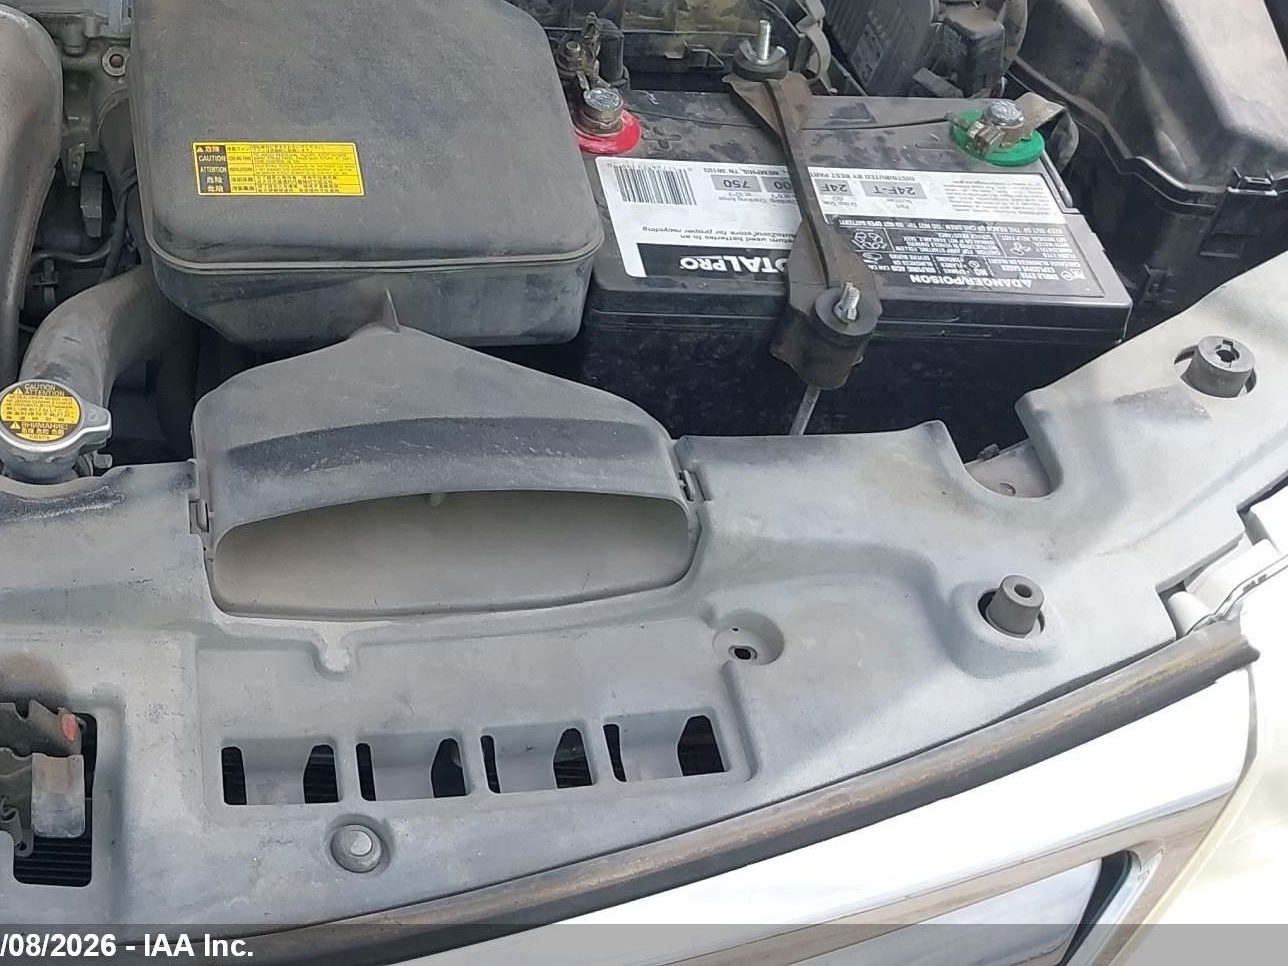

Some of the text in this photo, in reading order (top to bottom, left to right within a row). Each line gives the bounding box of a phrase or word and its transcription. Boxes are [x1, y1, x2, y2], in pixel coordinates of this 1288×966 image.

[723, 179, 750, 188] 750
[774, 180, 792, 190] 00
[820, 183, 848, 193] 24F
[872, 185, 916, 196] 24F-T
[910, 274, 1022, 288] DANGER/POISON
[24, 383, 56, 391] CAUTION
